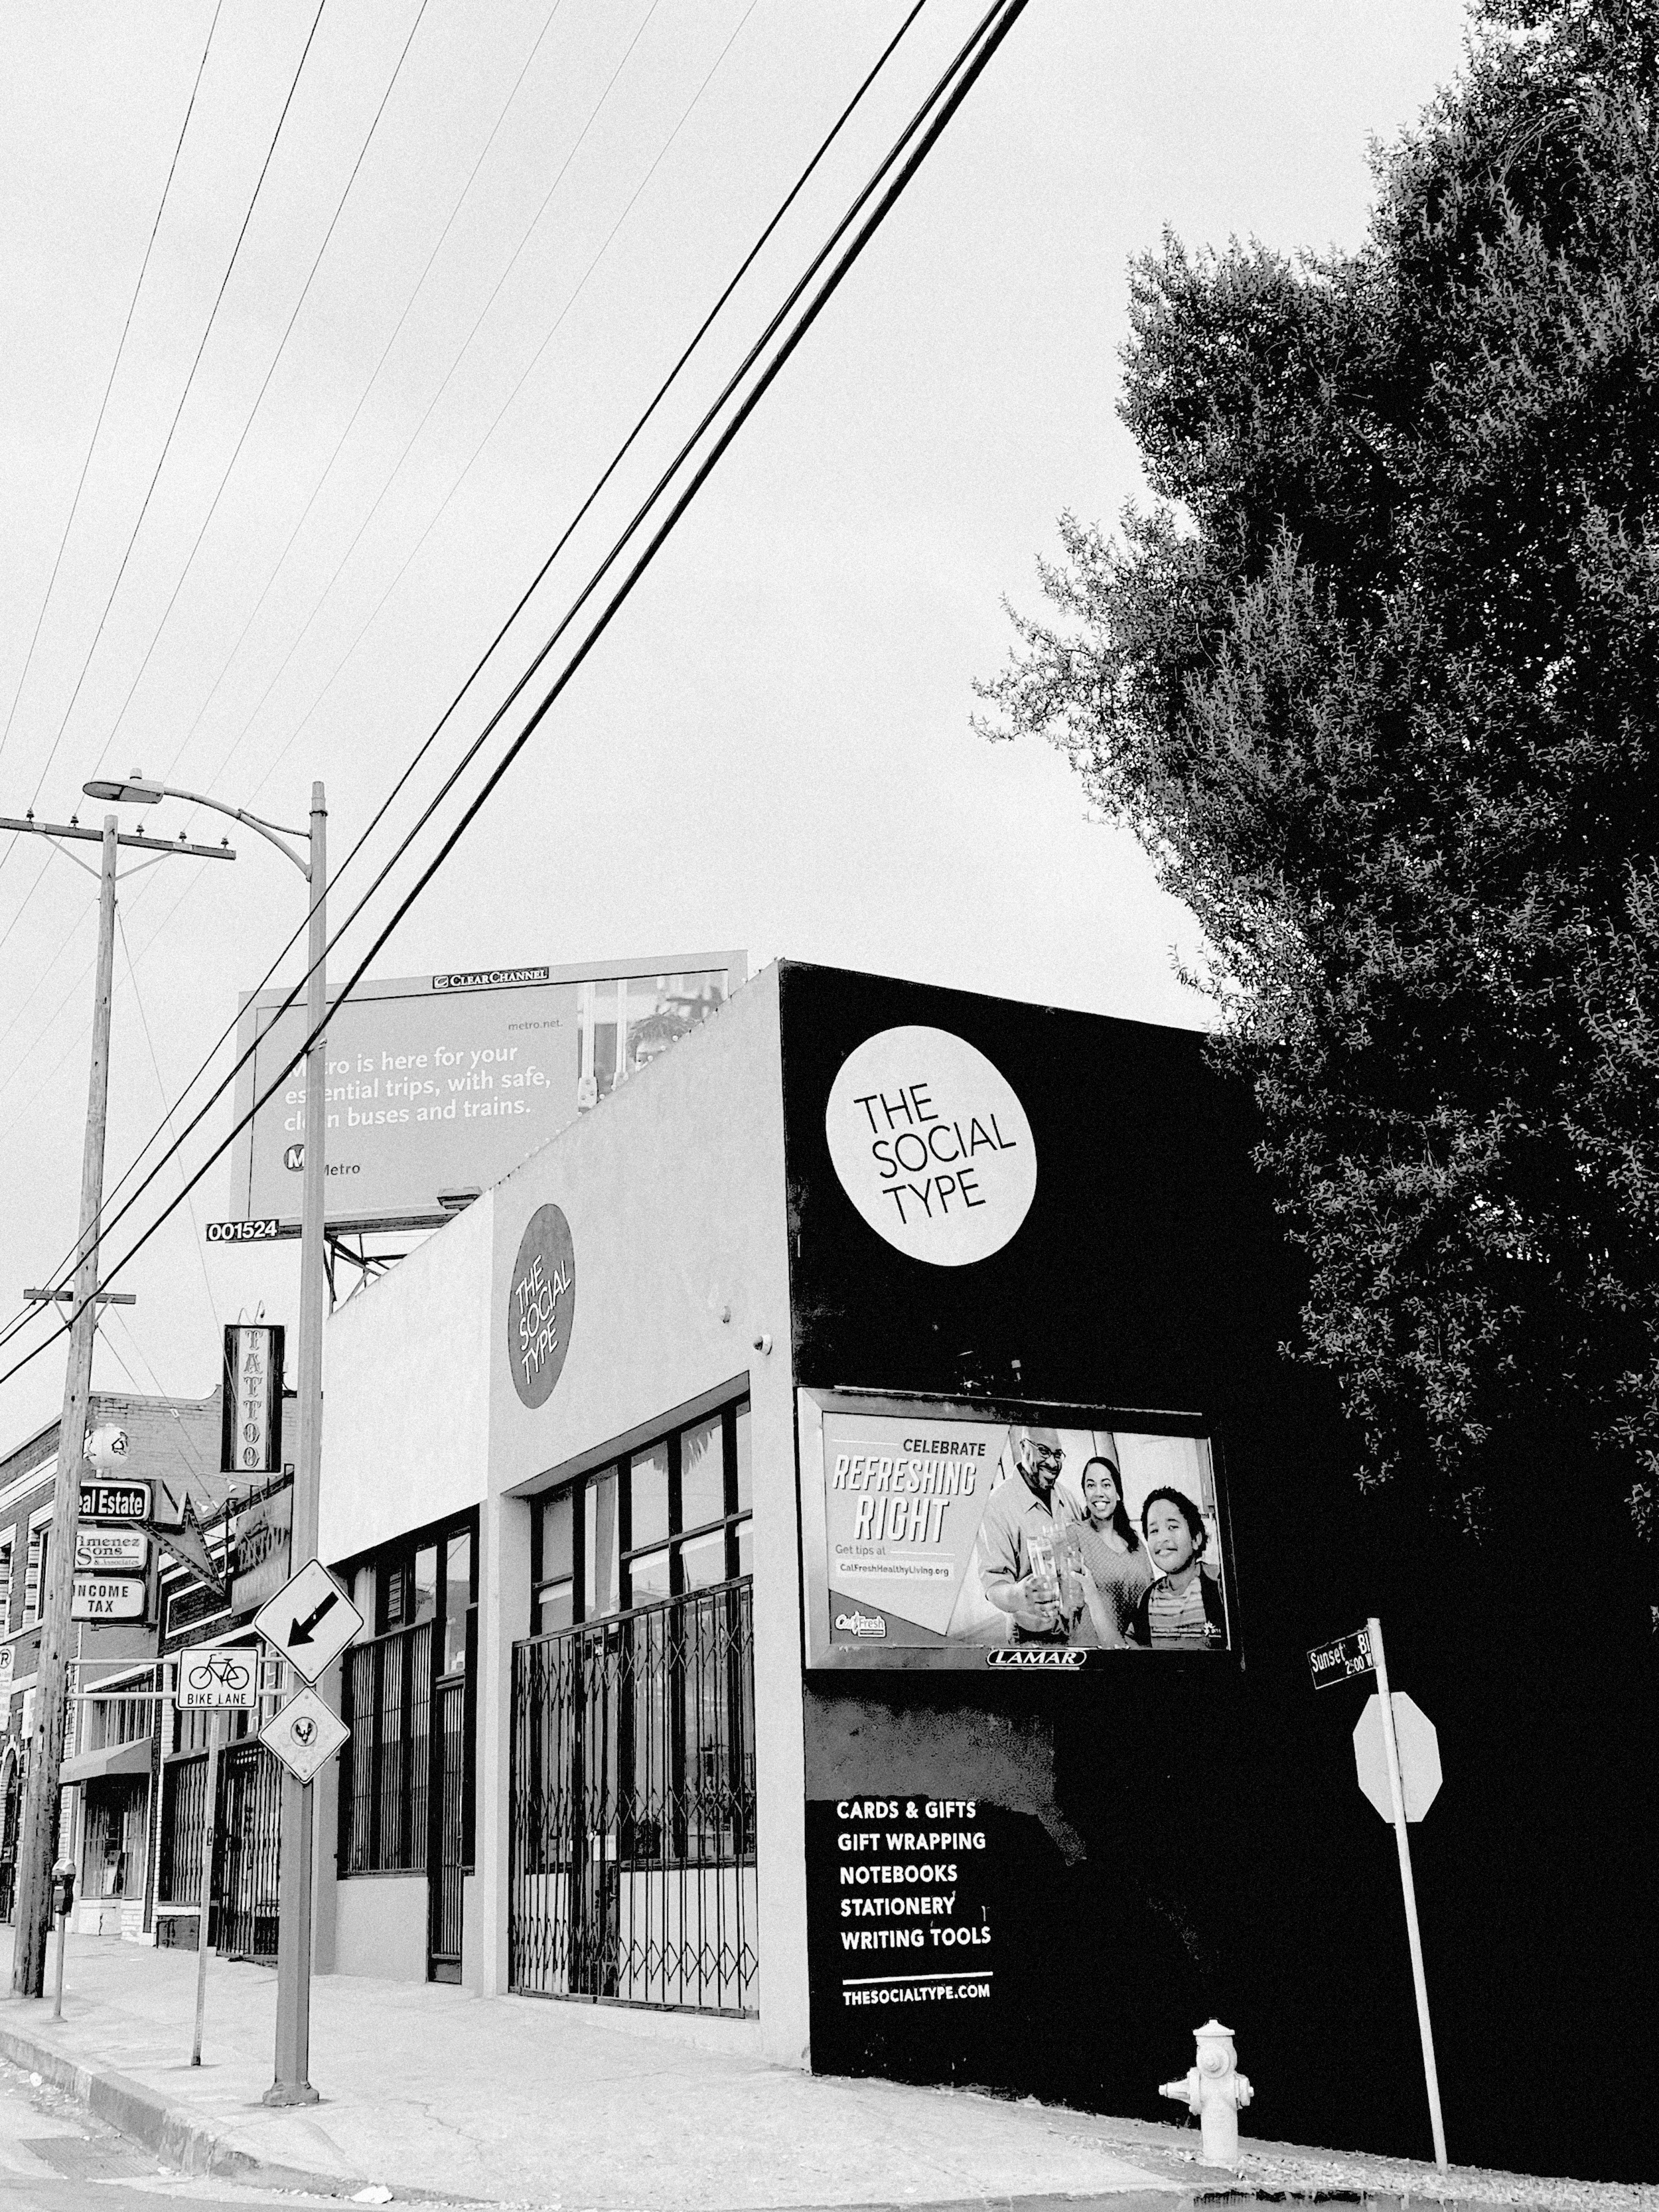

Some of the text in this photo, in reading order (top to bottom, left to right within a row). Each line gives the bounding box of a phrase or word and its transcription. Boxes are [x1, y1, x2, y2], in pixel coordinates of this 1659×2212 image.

[287, 1046, 518, 1078] Mro is here for your
[285, 1066, 551, 1104] esential trips, with safe,
[284, 1096, 531, 1132] cln buses and trains.
[853, 1082, 939, 1134] THE
[872, 1114, 1017, 1179] SOCIAL
[883, 1168, 986, 1224] TYPE
[208, 1220, 277, 1241] 001524
[514, 1254, 544, 1315] THE
[519, 1260, 571, 1352] SOCIAL
[522, 1315, 558, 1384] TYPE
[243, 1329, 263, 1469] TATTOO
[903, 1439, 986, 1457] CELEBRATE
[832, 1454, 977, 1496] REFRESHING
[98, 1489, 143, 1514] Estate
[854, 1495, 950, 1542] RIGHT
[76, 1547, 123, 1566] Sons
[835, 1544, 886, 1556] Get tips at
[840, 1563, 949, 1577] CalFreshHealthyLiving.org
[88, 1599, 113, 1613] TAX
[995, 1651, 1077, 1664] LAMAR
[1310, 1642, 1346, 1672] Sunset
[187, 1694, 246, 1704] BIKE LANE
[837, 1801, 976, 1819] CARDS & GIFTS
[837, 1832, 986, 1851] GIFT WRAPPING
[839, 1864, 958, 1884] NOTEBOOKS
[840, 1897, 955, 1917] STATIONERY
[841, 1927, 991, 1950] WRITING TOOLS
[843, 1984, 991, 2006] THESOCIALTYPE.COM
